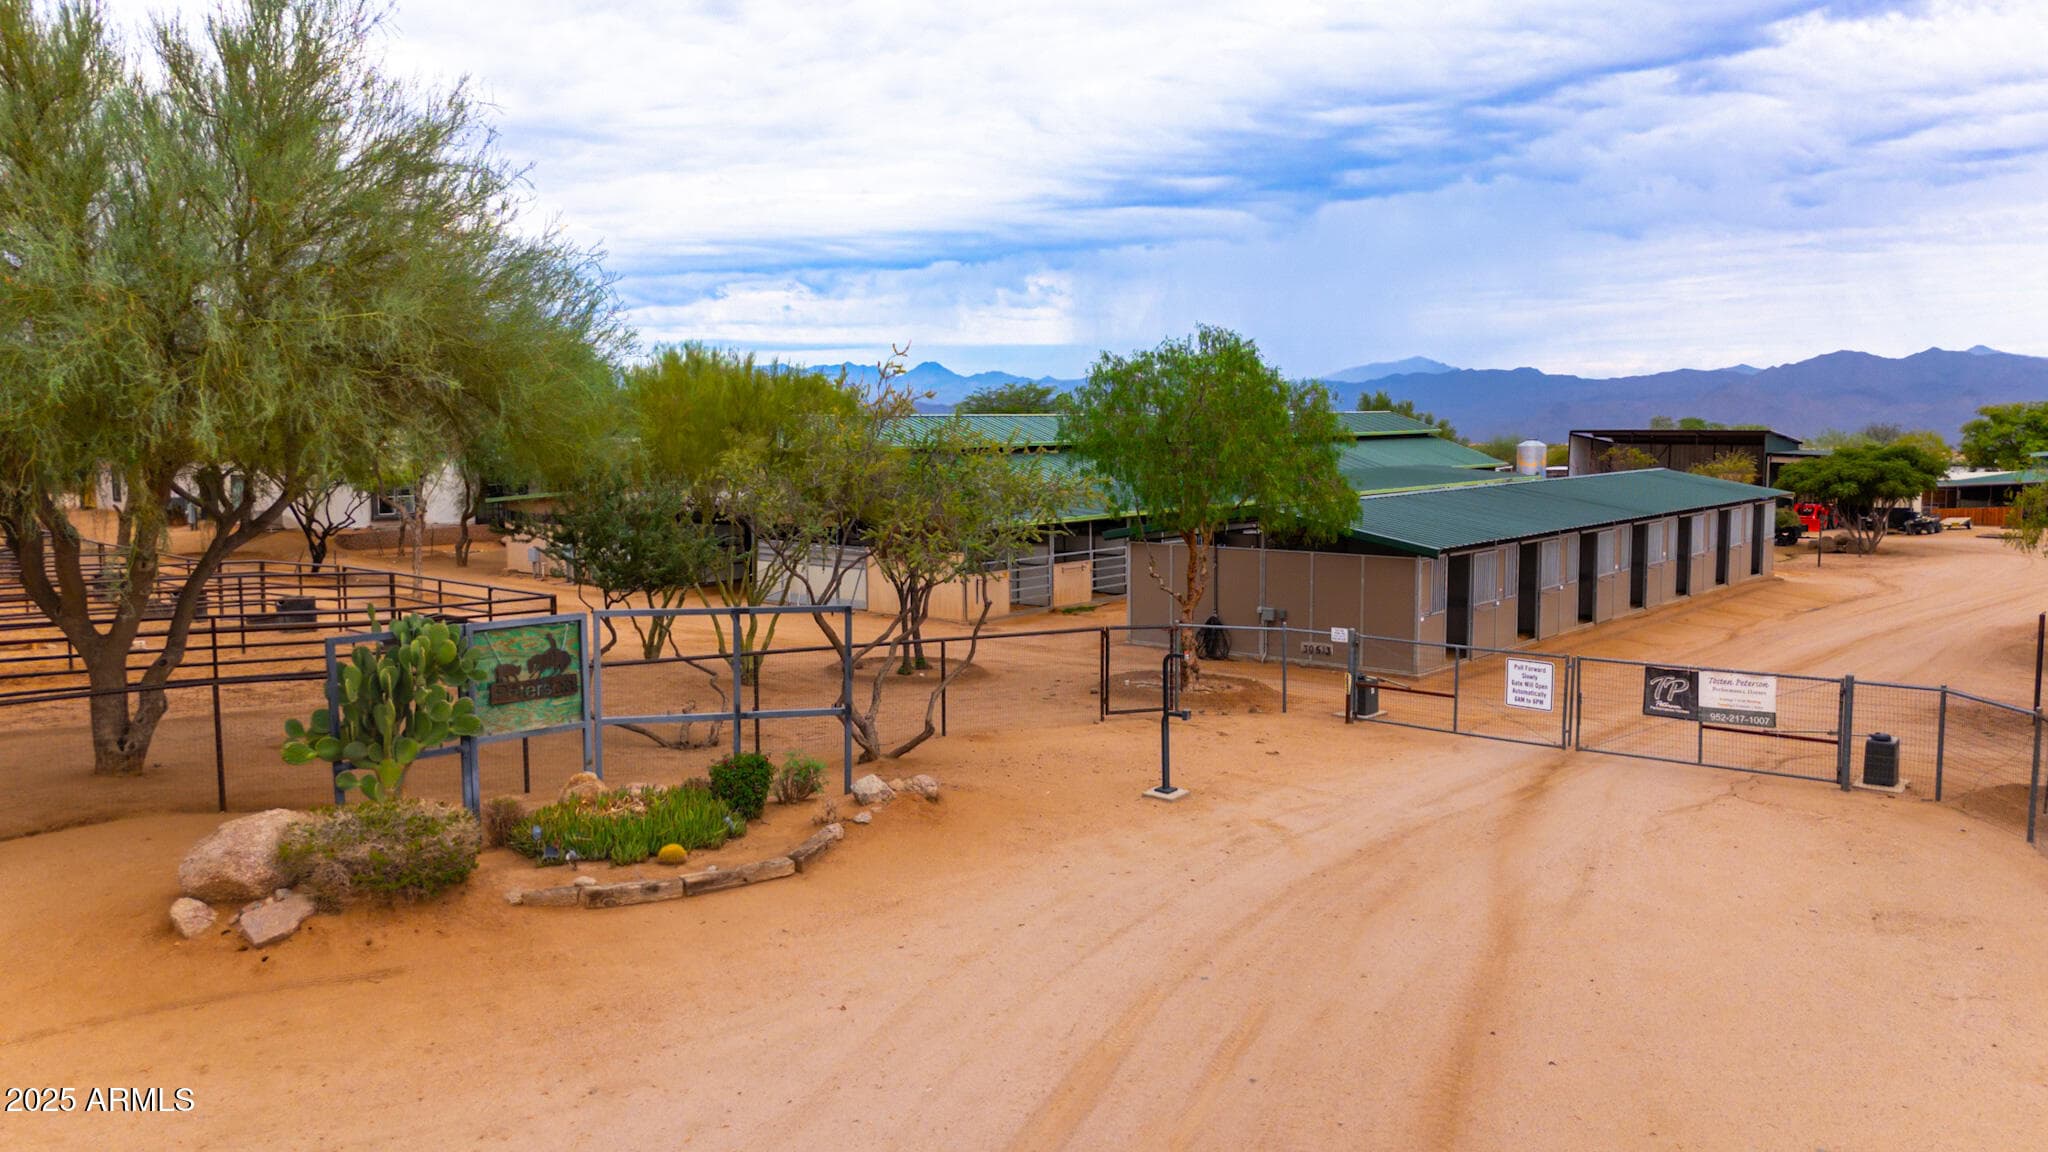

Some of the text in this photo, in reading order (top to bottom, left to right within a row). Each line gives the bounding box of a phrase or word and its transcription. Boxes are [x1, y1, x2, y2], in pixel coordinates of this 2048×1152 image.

[1525, 665, 1547, 673] Forward
[1521, 672, 1538, 680] Slowly
[1735, 678, 1770, 689] Peterson
[1710, 712, 1771, 725] 952-217-1007
